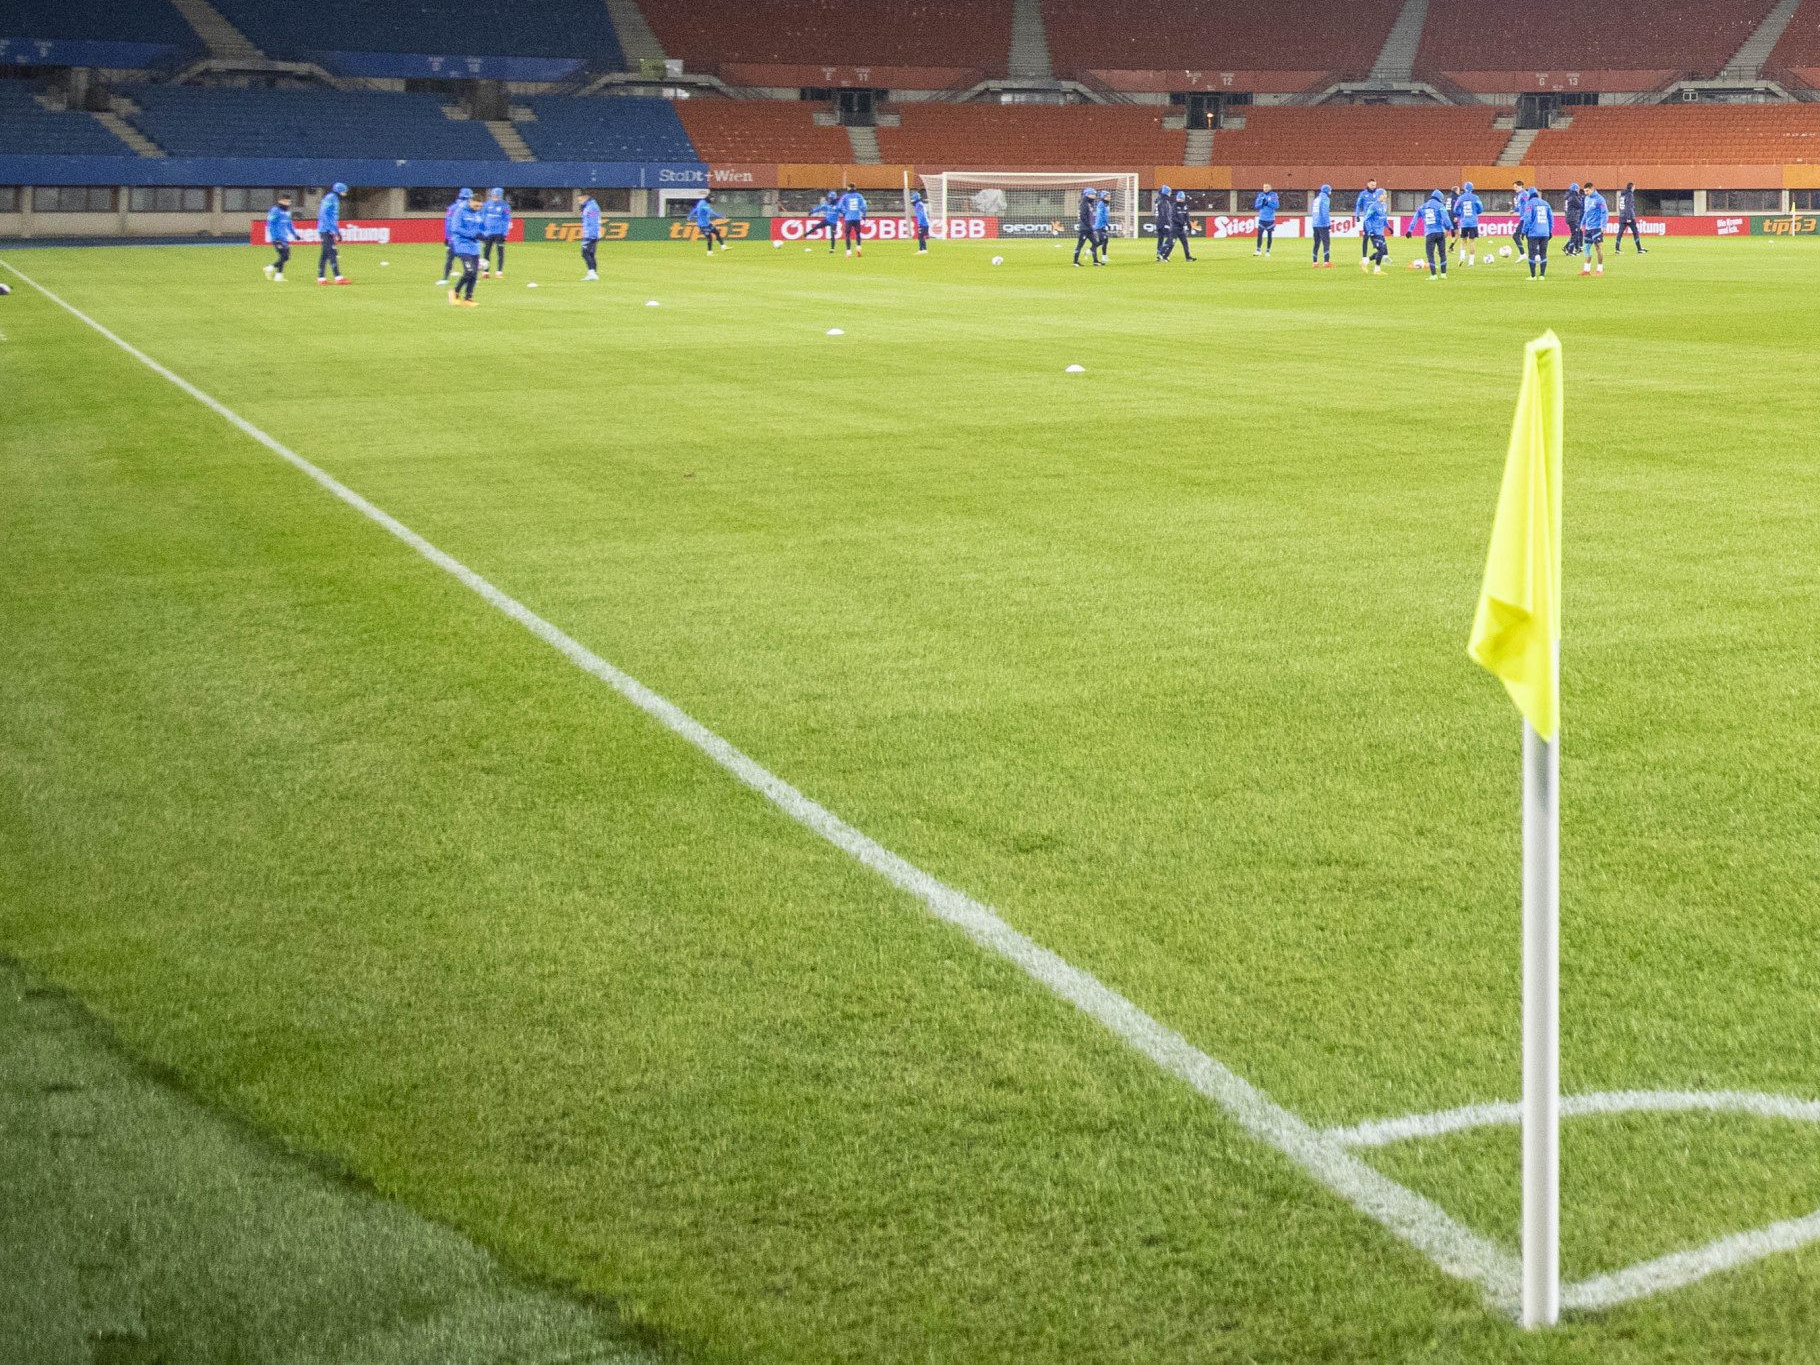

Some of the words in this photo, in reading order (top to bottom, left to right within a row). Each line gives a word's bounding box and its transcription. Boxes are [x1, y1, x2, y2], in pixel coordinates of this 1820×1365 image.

[713, 168, 753, 182] Wien
[781, 219, 843, 240] ÖBB
[858, 219, 915, 239] ÖBB
[927, 219, 986, 239] ÖBB
[1330, 217, 1357, 234] iegl
[1477, 221, 1520, 235] gent
[1763, 216, 1817, 235] tipp3
